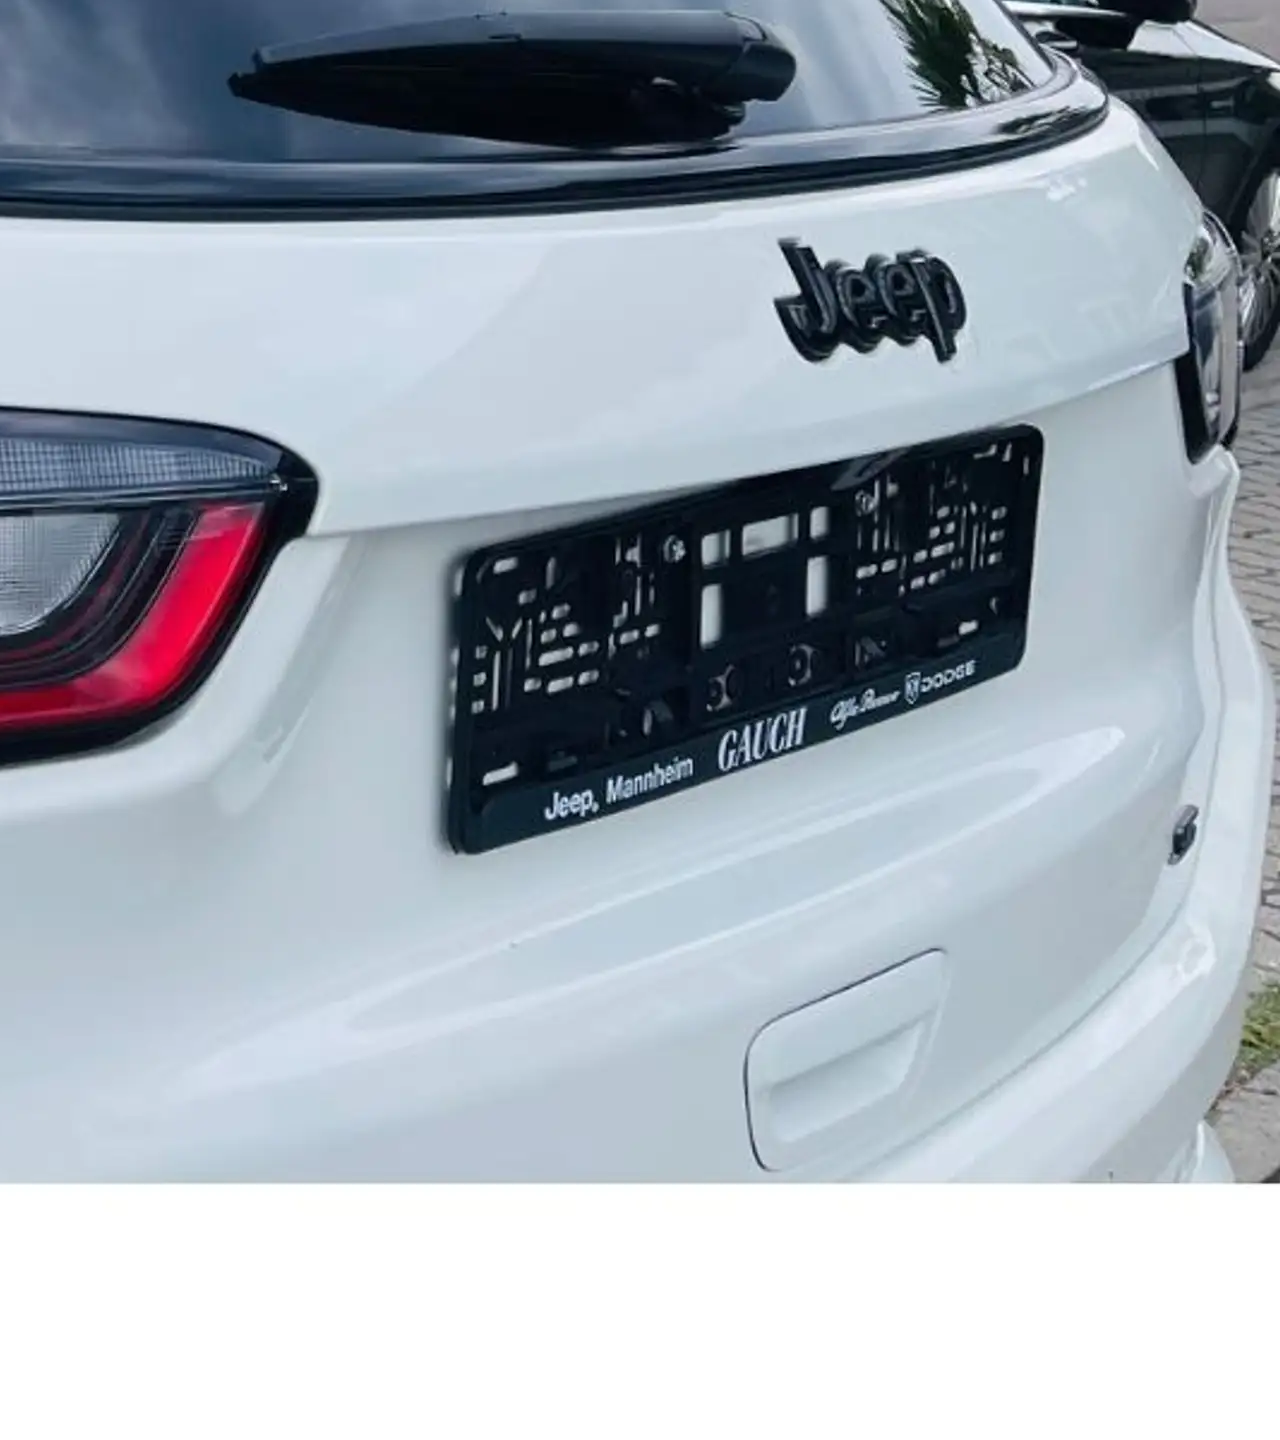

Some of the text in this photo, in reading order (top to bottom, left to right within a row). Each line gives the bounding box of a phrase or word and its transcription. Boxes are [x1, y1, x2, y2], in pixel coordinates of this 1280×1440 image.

[773, 237, 967, 364] Jeep
[605, 756, 694, 804] Mannheim
[718, 707, 808, 772] GAUCH
